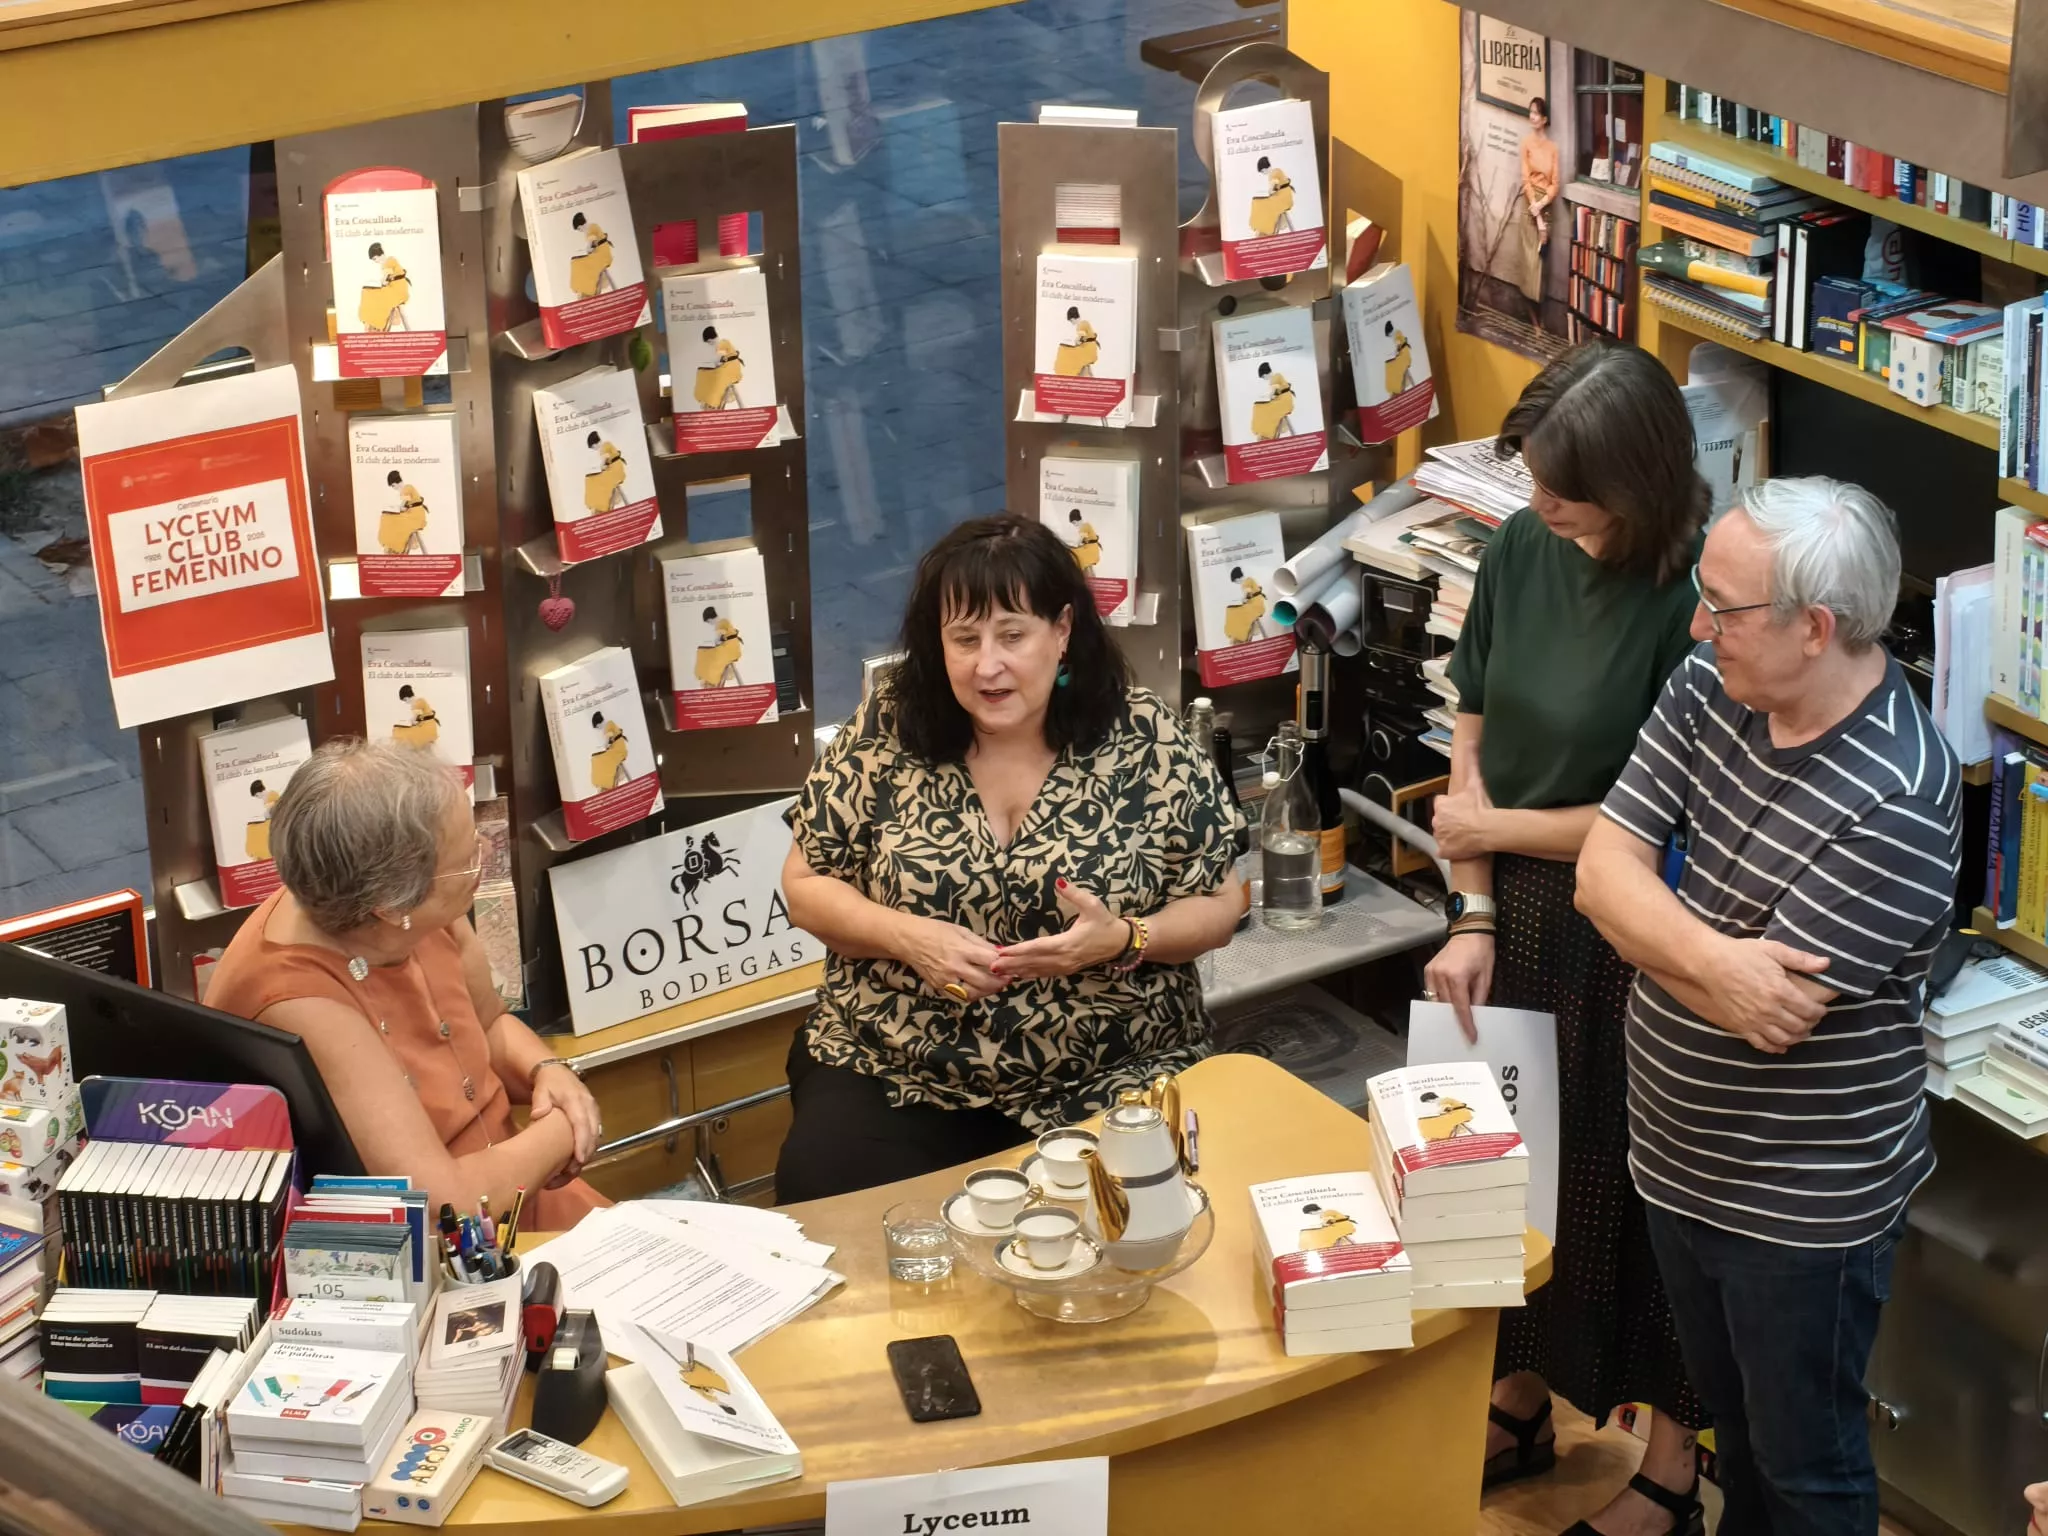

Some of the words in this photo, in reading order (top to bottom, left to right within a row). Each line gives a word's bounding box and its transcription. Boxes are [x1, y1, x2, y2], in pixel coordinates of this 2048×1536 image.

[1482, 39, 1542, 72] LIBRERÍA
[1226, 137, 1240, 145] Eva
[1250, 143, 1259, 152] de
[538, 194, 552, 204] Eva
[335, 218, 350, 226] Eva
[335, 229, 345, 238] El
[362, 228, 372, 236] de
[373, 228, 384, 236] las
[1041, 280, 1054, 288] Eva
[1063, 292, 1072, 300] de
[670, 303, 685, 311] Eva
[554, 414, 568, 424] Eva
[579, 418, 587, 428] de
[356, 444, 370, 453] Eva
[371, 445, 419, 453] Cosculluela
[356, 455, 365, 463] El
[365, 455, 381, 463] club
[381, 455, 391, 463] de
[392, 455, 402, 464] las
[403, 455, 441, 464] modernas
[1045, 482, 1057, 491] Eva
[177, 495, 219, 511] Centenario
[145, 501, 257, 545] LYCEVM
[168, 530, 242, 565] CLUB
[132, 546, 283, 597] FEMENINO
[671, 585, 685, 593] Eva
[696, 593, 706, 602] de
[368, 671, 377, 679] El
[215, 762, 230, 771] Eva
[217, 772, 226, 781] El
[242, 766, 252, 776] de
[253, 764, 263, 774] las
[577, 887, 796, 995] BORSA
[638, 942, 805, 1010] BODEGAS
[1261, 1195, 1278, 1203] Eva
[1293, 1196, 1304, 1204] de
[314, 1284, 342, 1298] 105
[278, 1327, 322, 1338] Sudokus
[288, 1350, 335, 1359] palabras
[451, 1417, 472, 1439] MEMO
[903, 1505, 1030, 1536] Lyceum
